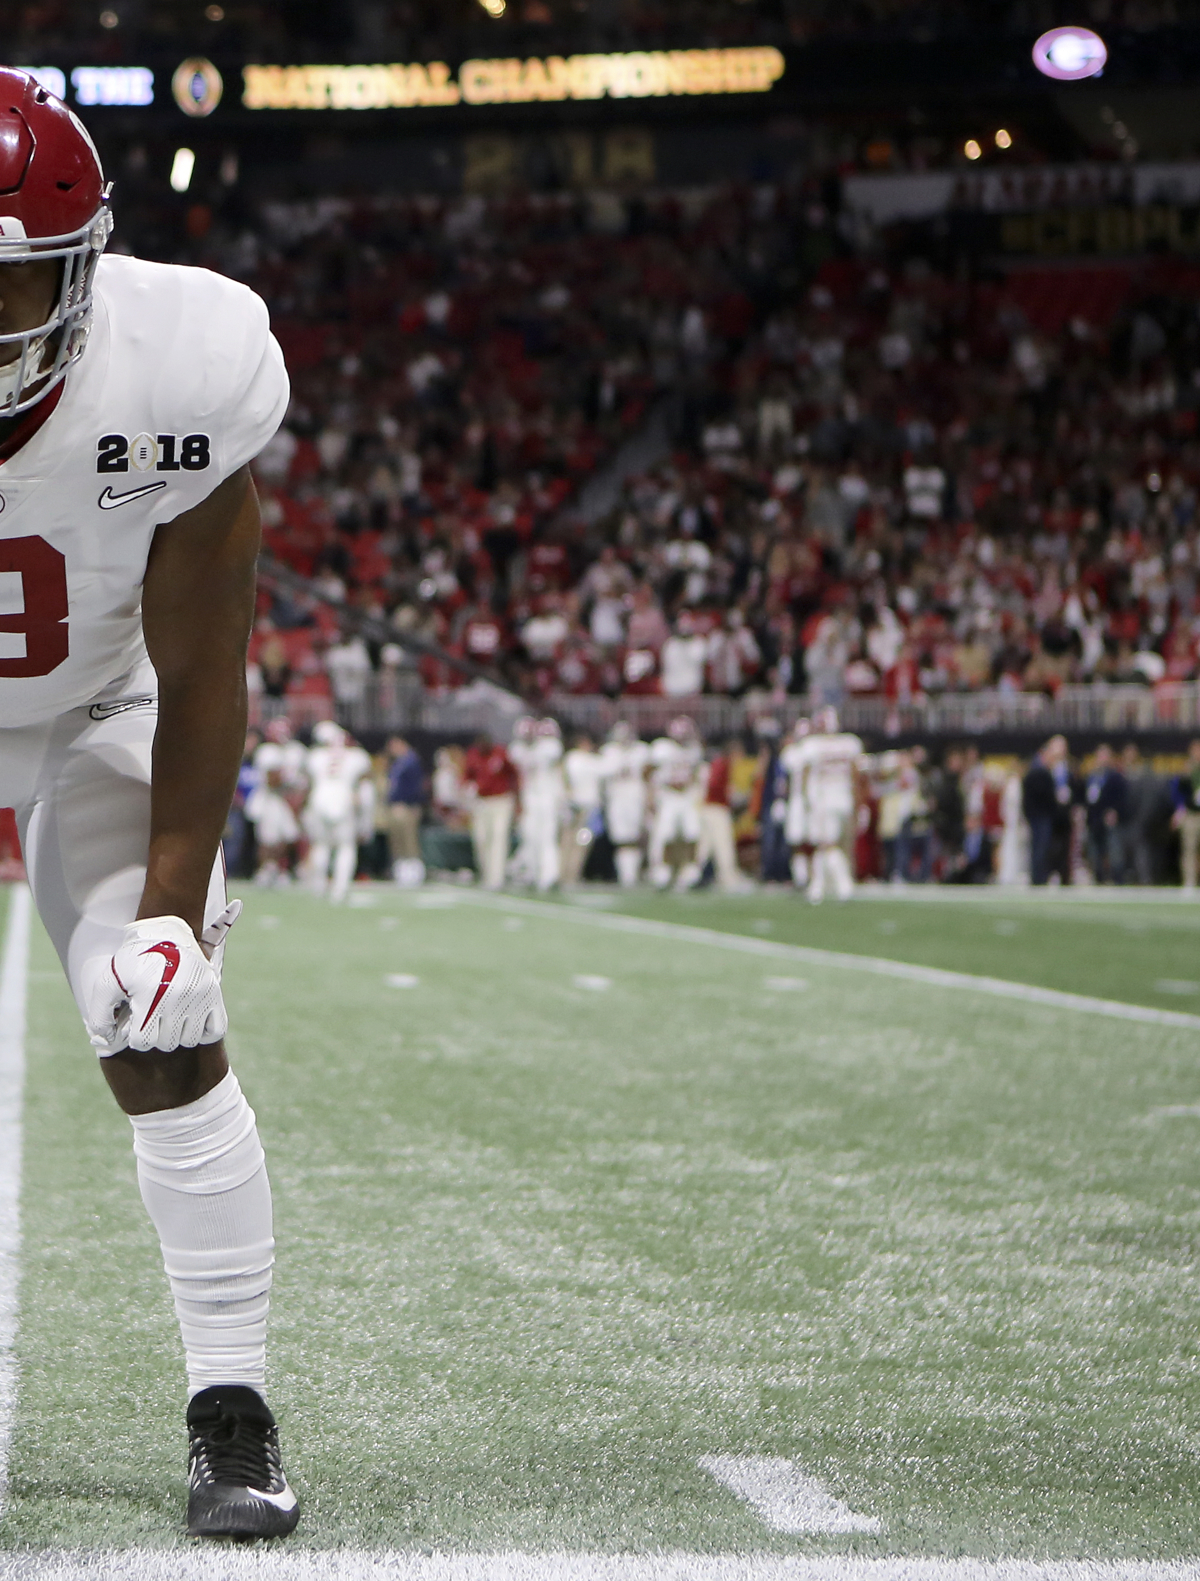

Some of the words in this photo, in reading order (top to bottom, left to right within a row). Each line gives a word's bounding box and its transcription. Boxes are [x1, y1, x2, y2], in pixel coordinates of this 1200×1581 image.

[70, 66, 154, 105] THE
[242, 62, 460, 109] NATIONAL
[458, 46, 784, 103] CHAMPIONSHIP
[97, 432, 211, 474] 2018
